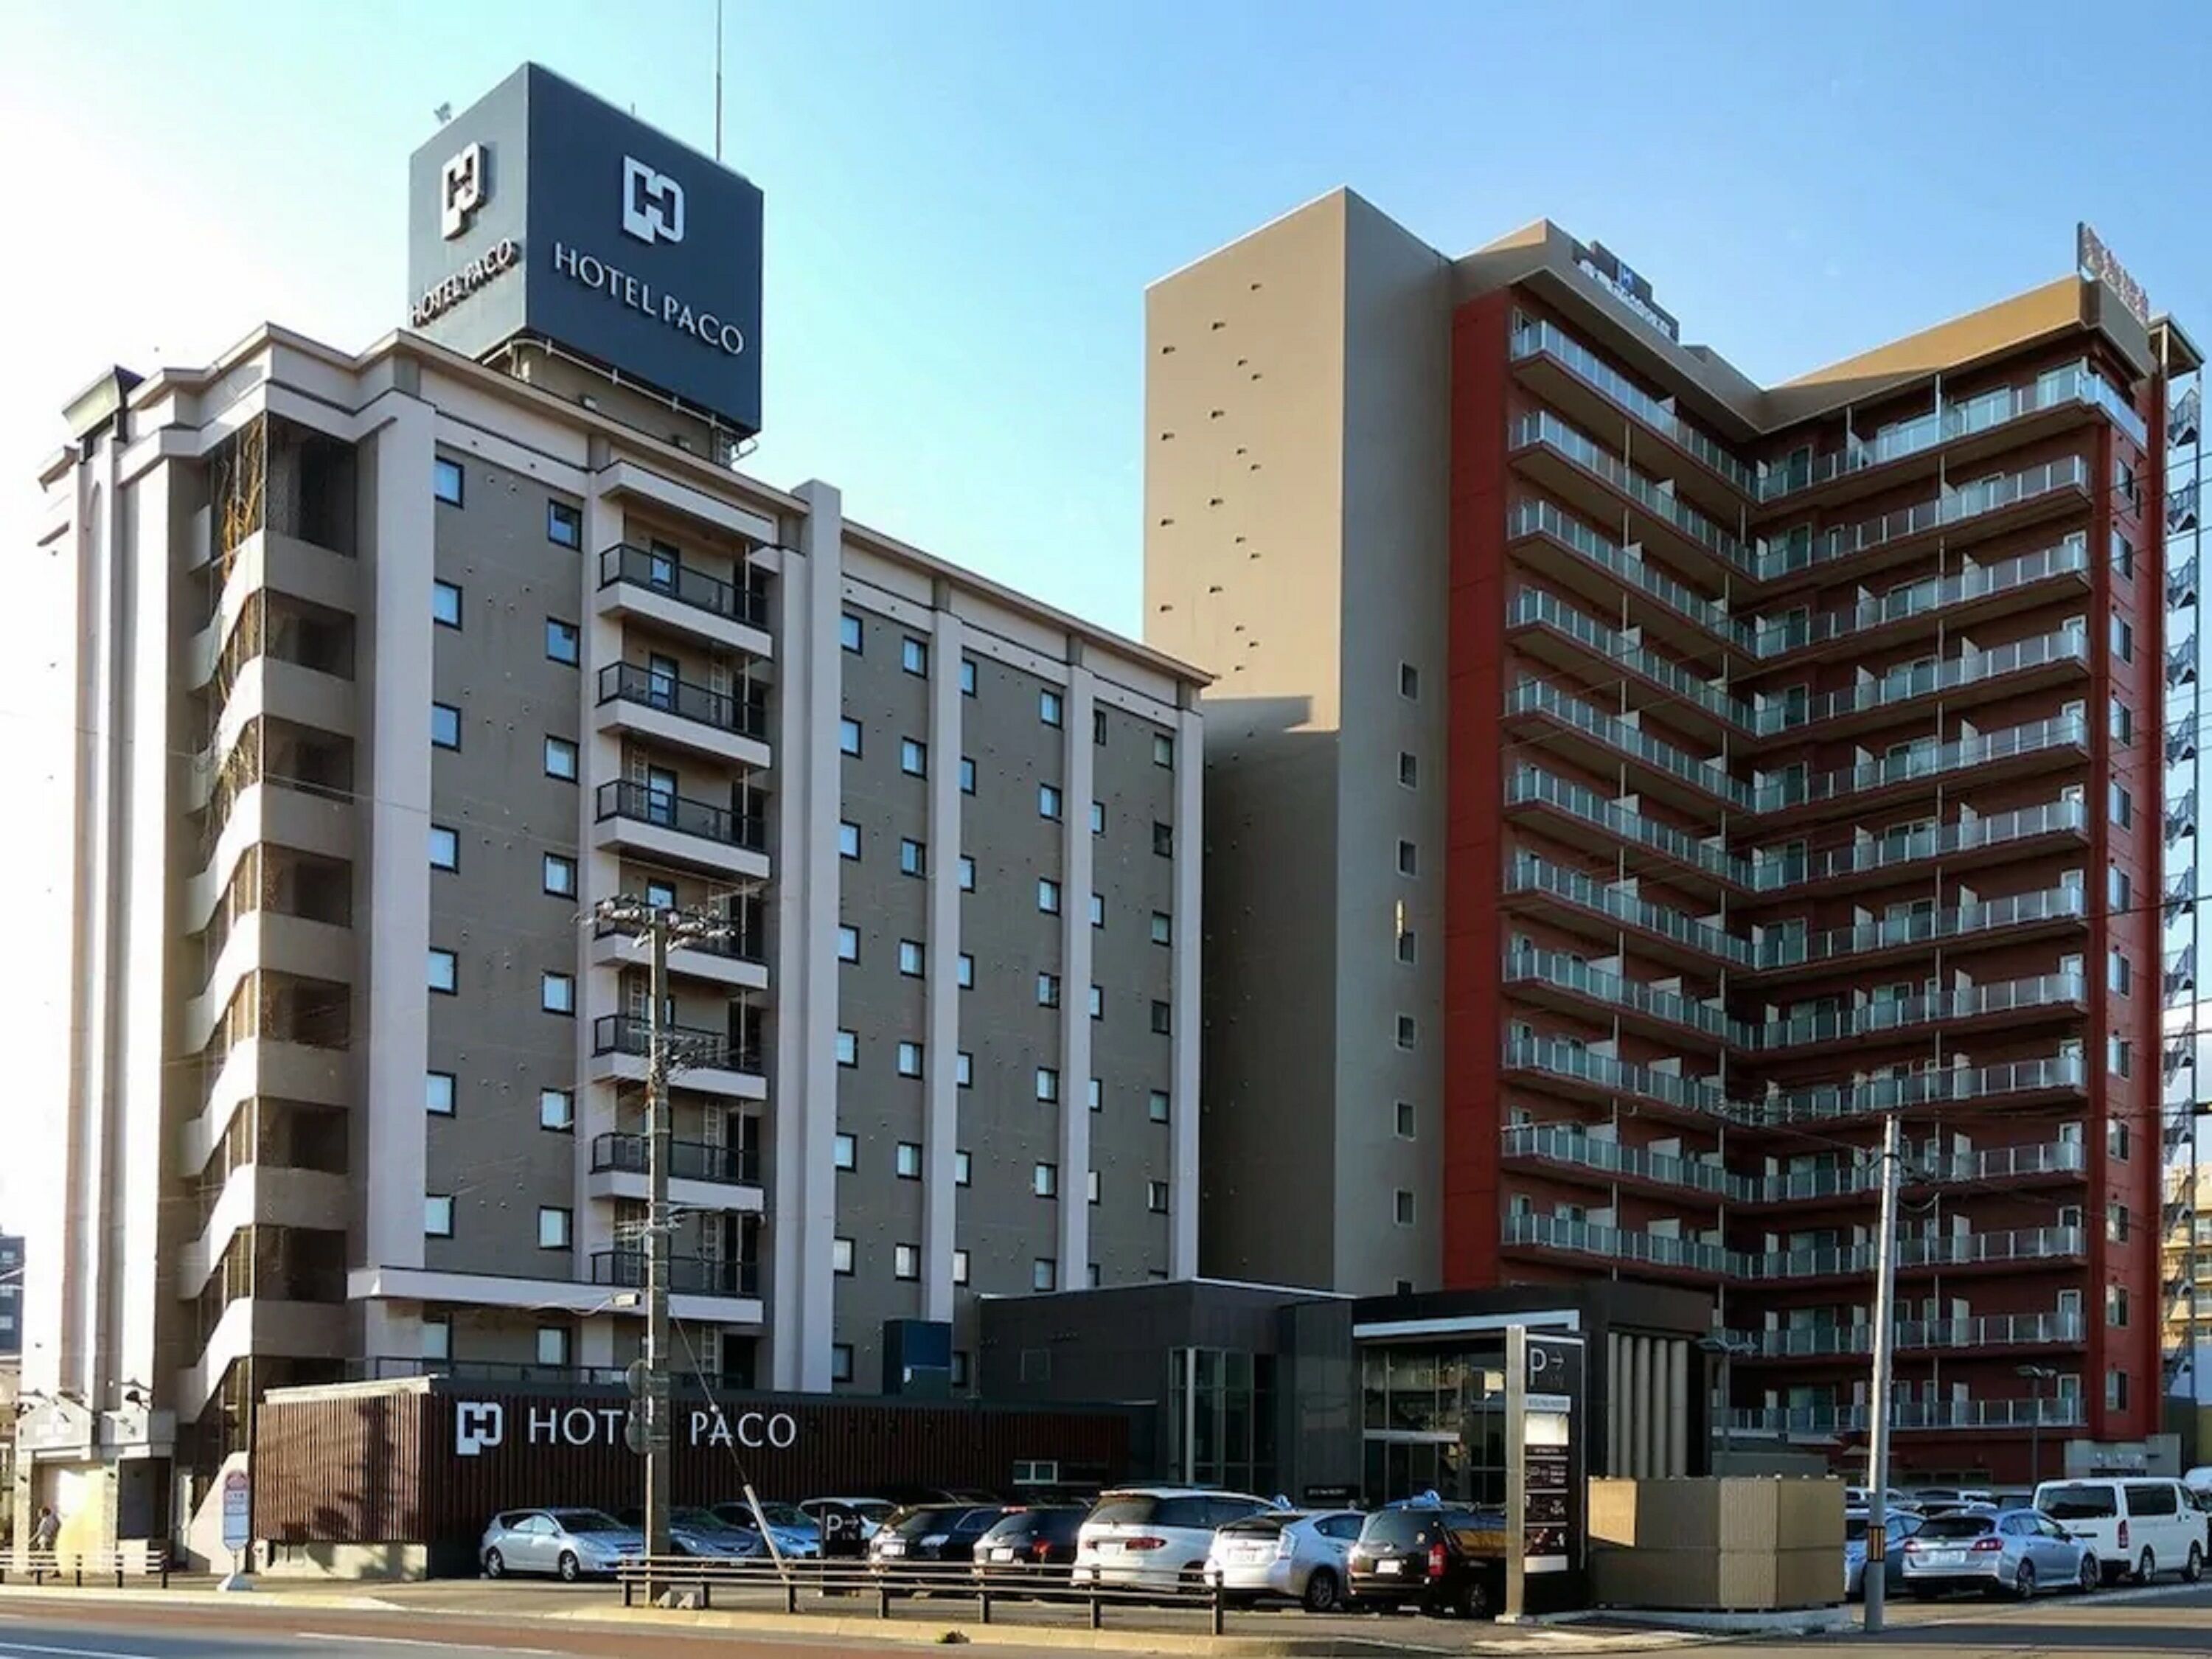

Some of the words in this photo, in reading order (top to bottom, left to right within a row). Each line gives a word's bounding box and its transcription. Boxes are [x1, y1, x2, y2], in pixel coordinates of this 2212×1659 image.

[410, 274, 462, 326] HOTEL
[464, 237, 513, 291] PACO
[554, 241, 657, 316] HOTEL
[663, 293, 745, 355] PACO
[1530, 1347, 1548, 1386] P
[529, 1407, 636, 1445] HOT
[691, 1410, 797, 1448] PACO
[827, 1514, 843, 1541] P
